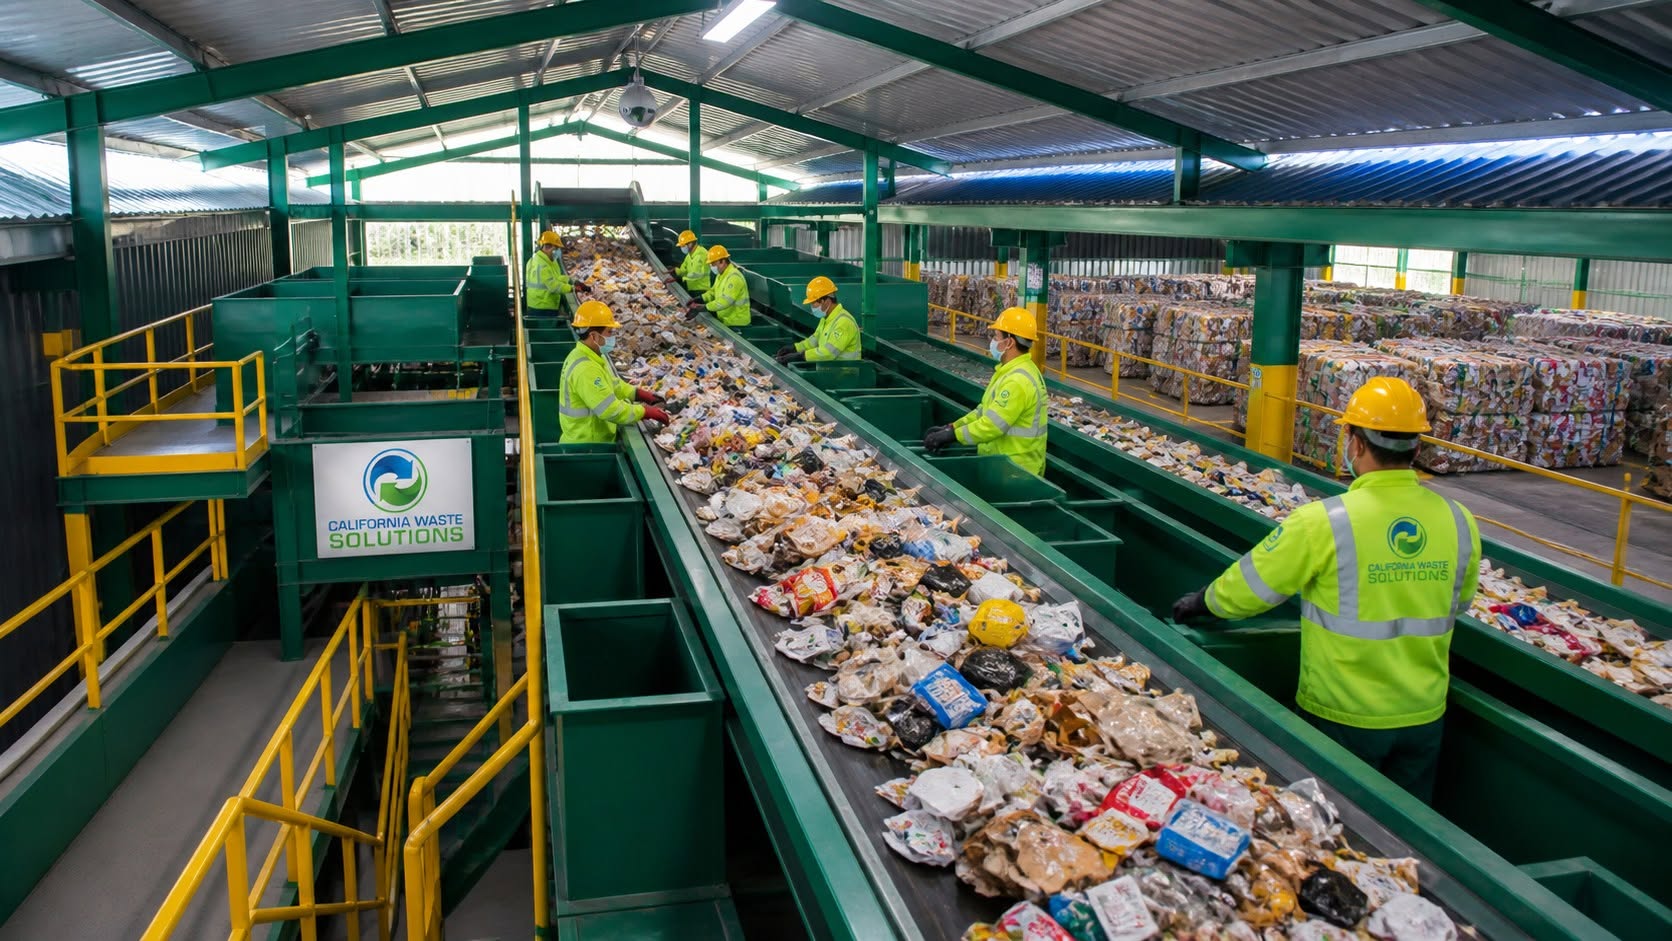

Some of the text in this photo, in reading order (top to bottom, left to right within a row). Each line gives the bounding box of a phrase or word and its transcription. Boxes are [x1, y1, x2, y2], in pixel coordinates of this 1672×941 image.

[328, 514, 464, 532] CALIFORNIA WASTE
[329, 527, 464, 549] SOLUTIONS
[1417, 560, 1448, 569] WASTE
[1368, 570, 1449, 584] SOLUTIONS
